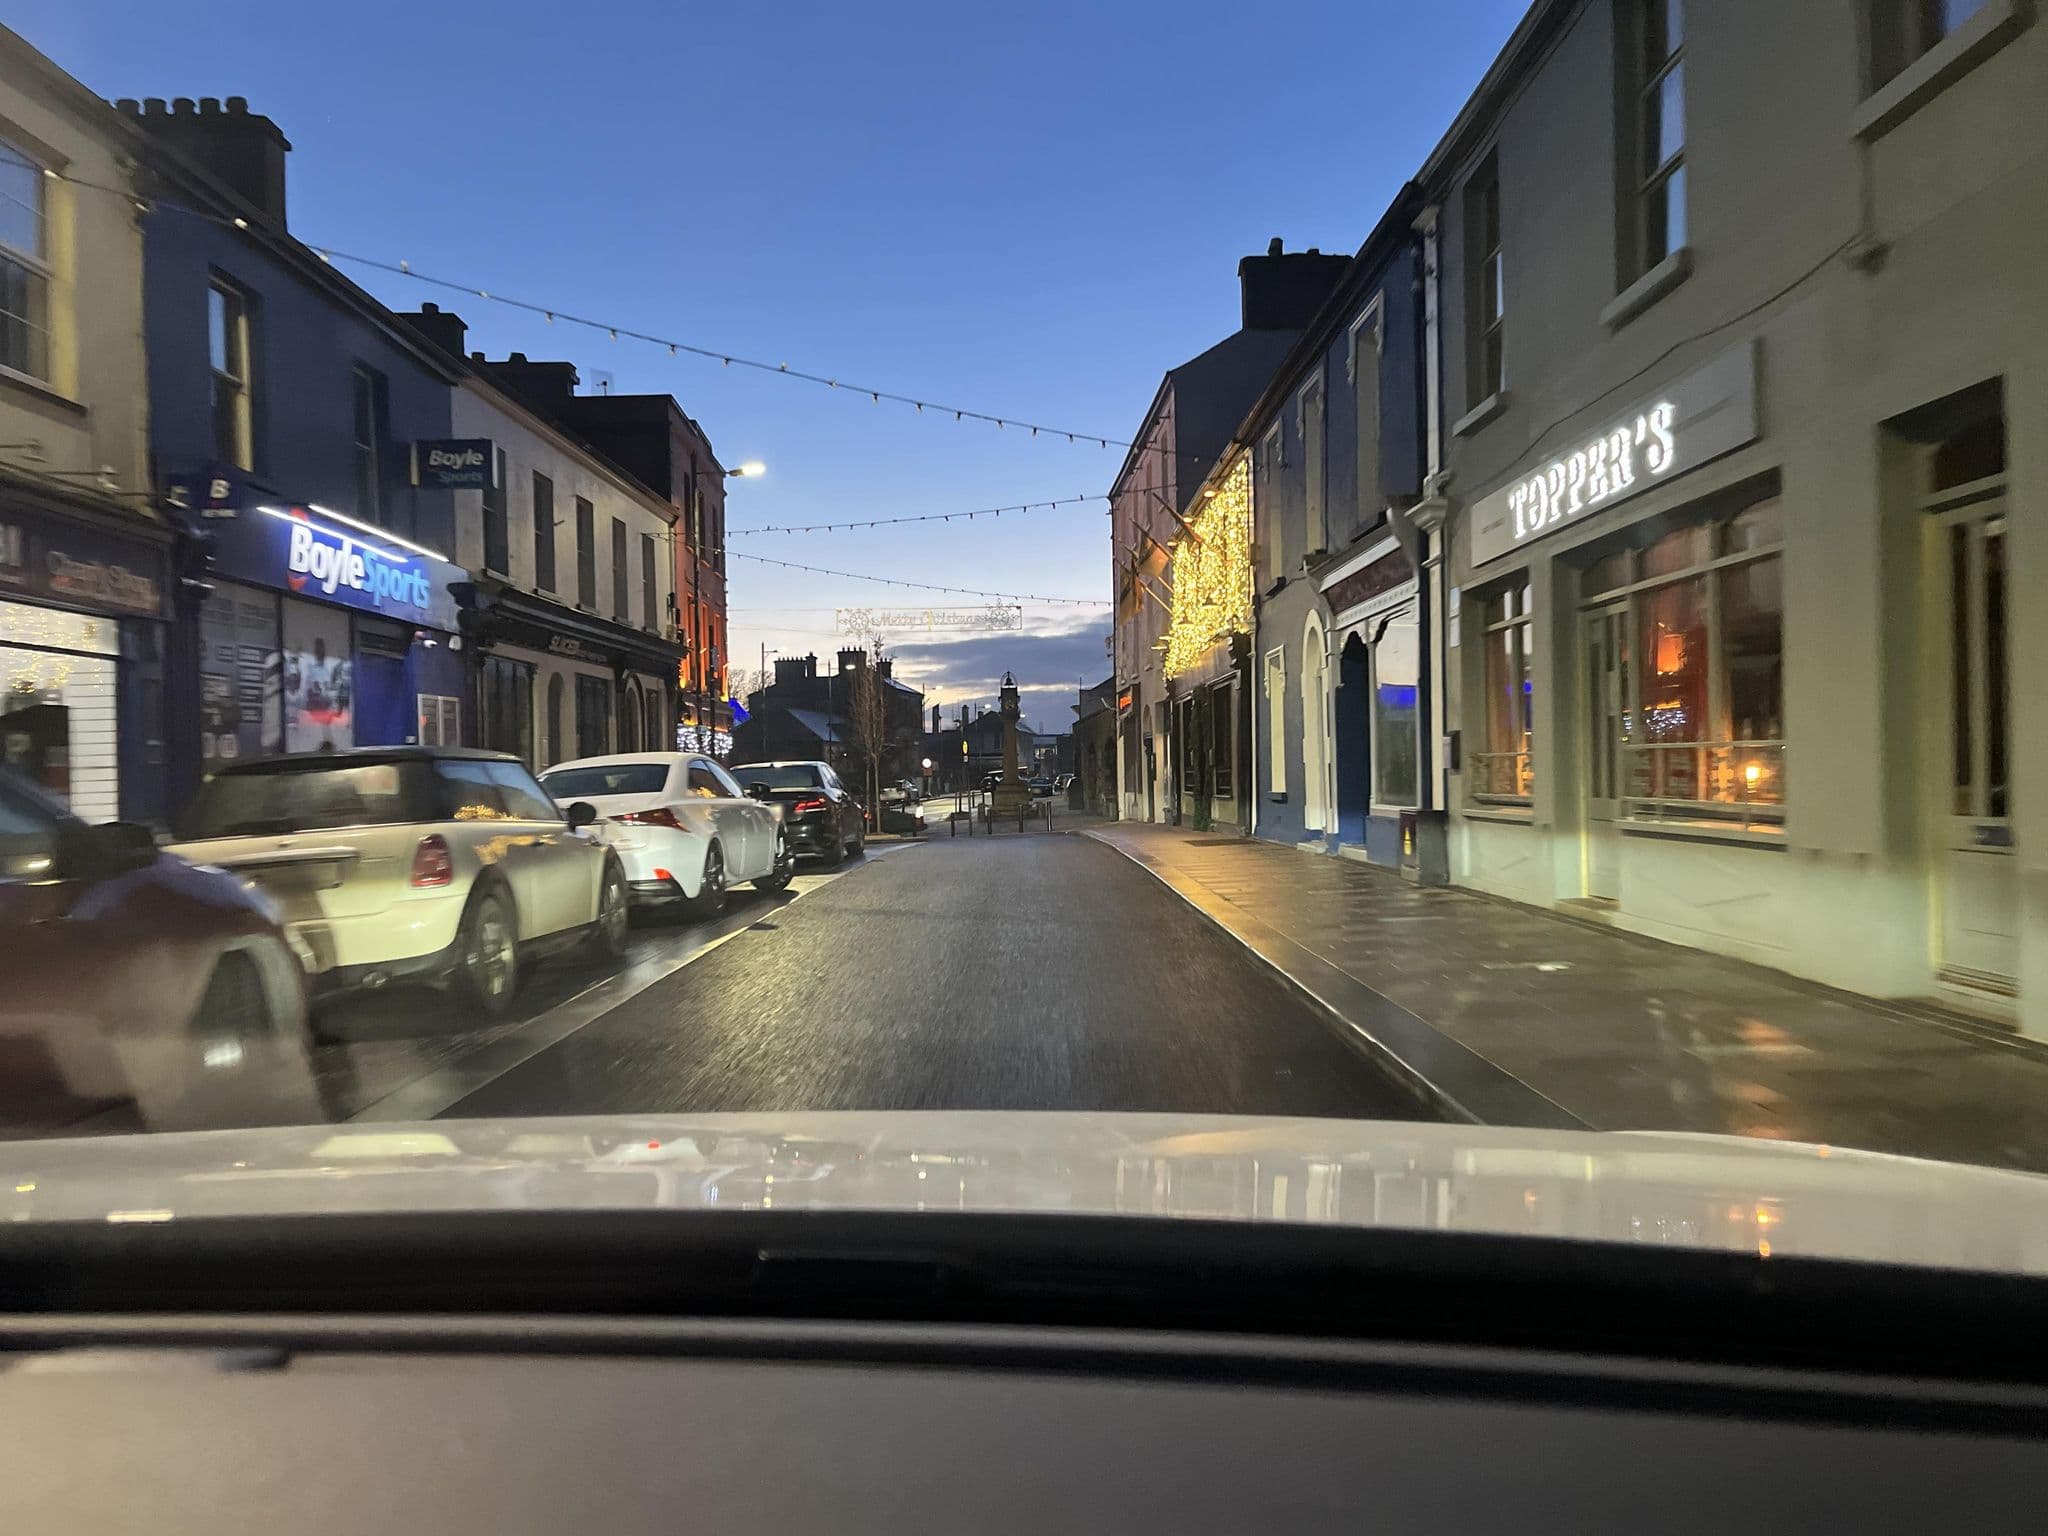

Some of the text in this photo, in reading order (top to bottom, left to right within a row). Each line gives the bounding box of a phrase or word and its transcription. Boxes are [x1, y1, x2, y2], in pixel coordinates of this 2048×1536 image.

[429, 448, 484, 470] Boyle
[1508, 401, 1676, 539] TOPPER'S
[210, 479, 231, 498] B
[288, 524, 431, 609] BoyleSports
